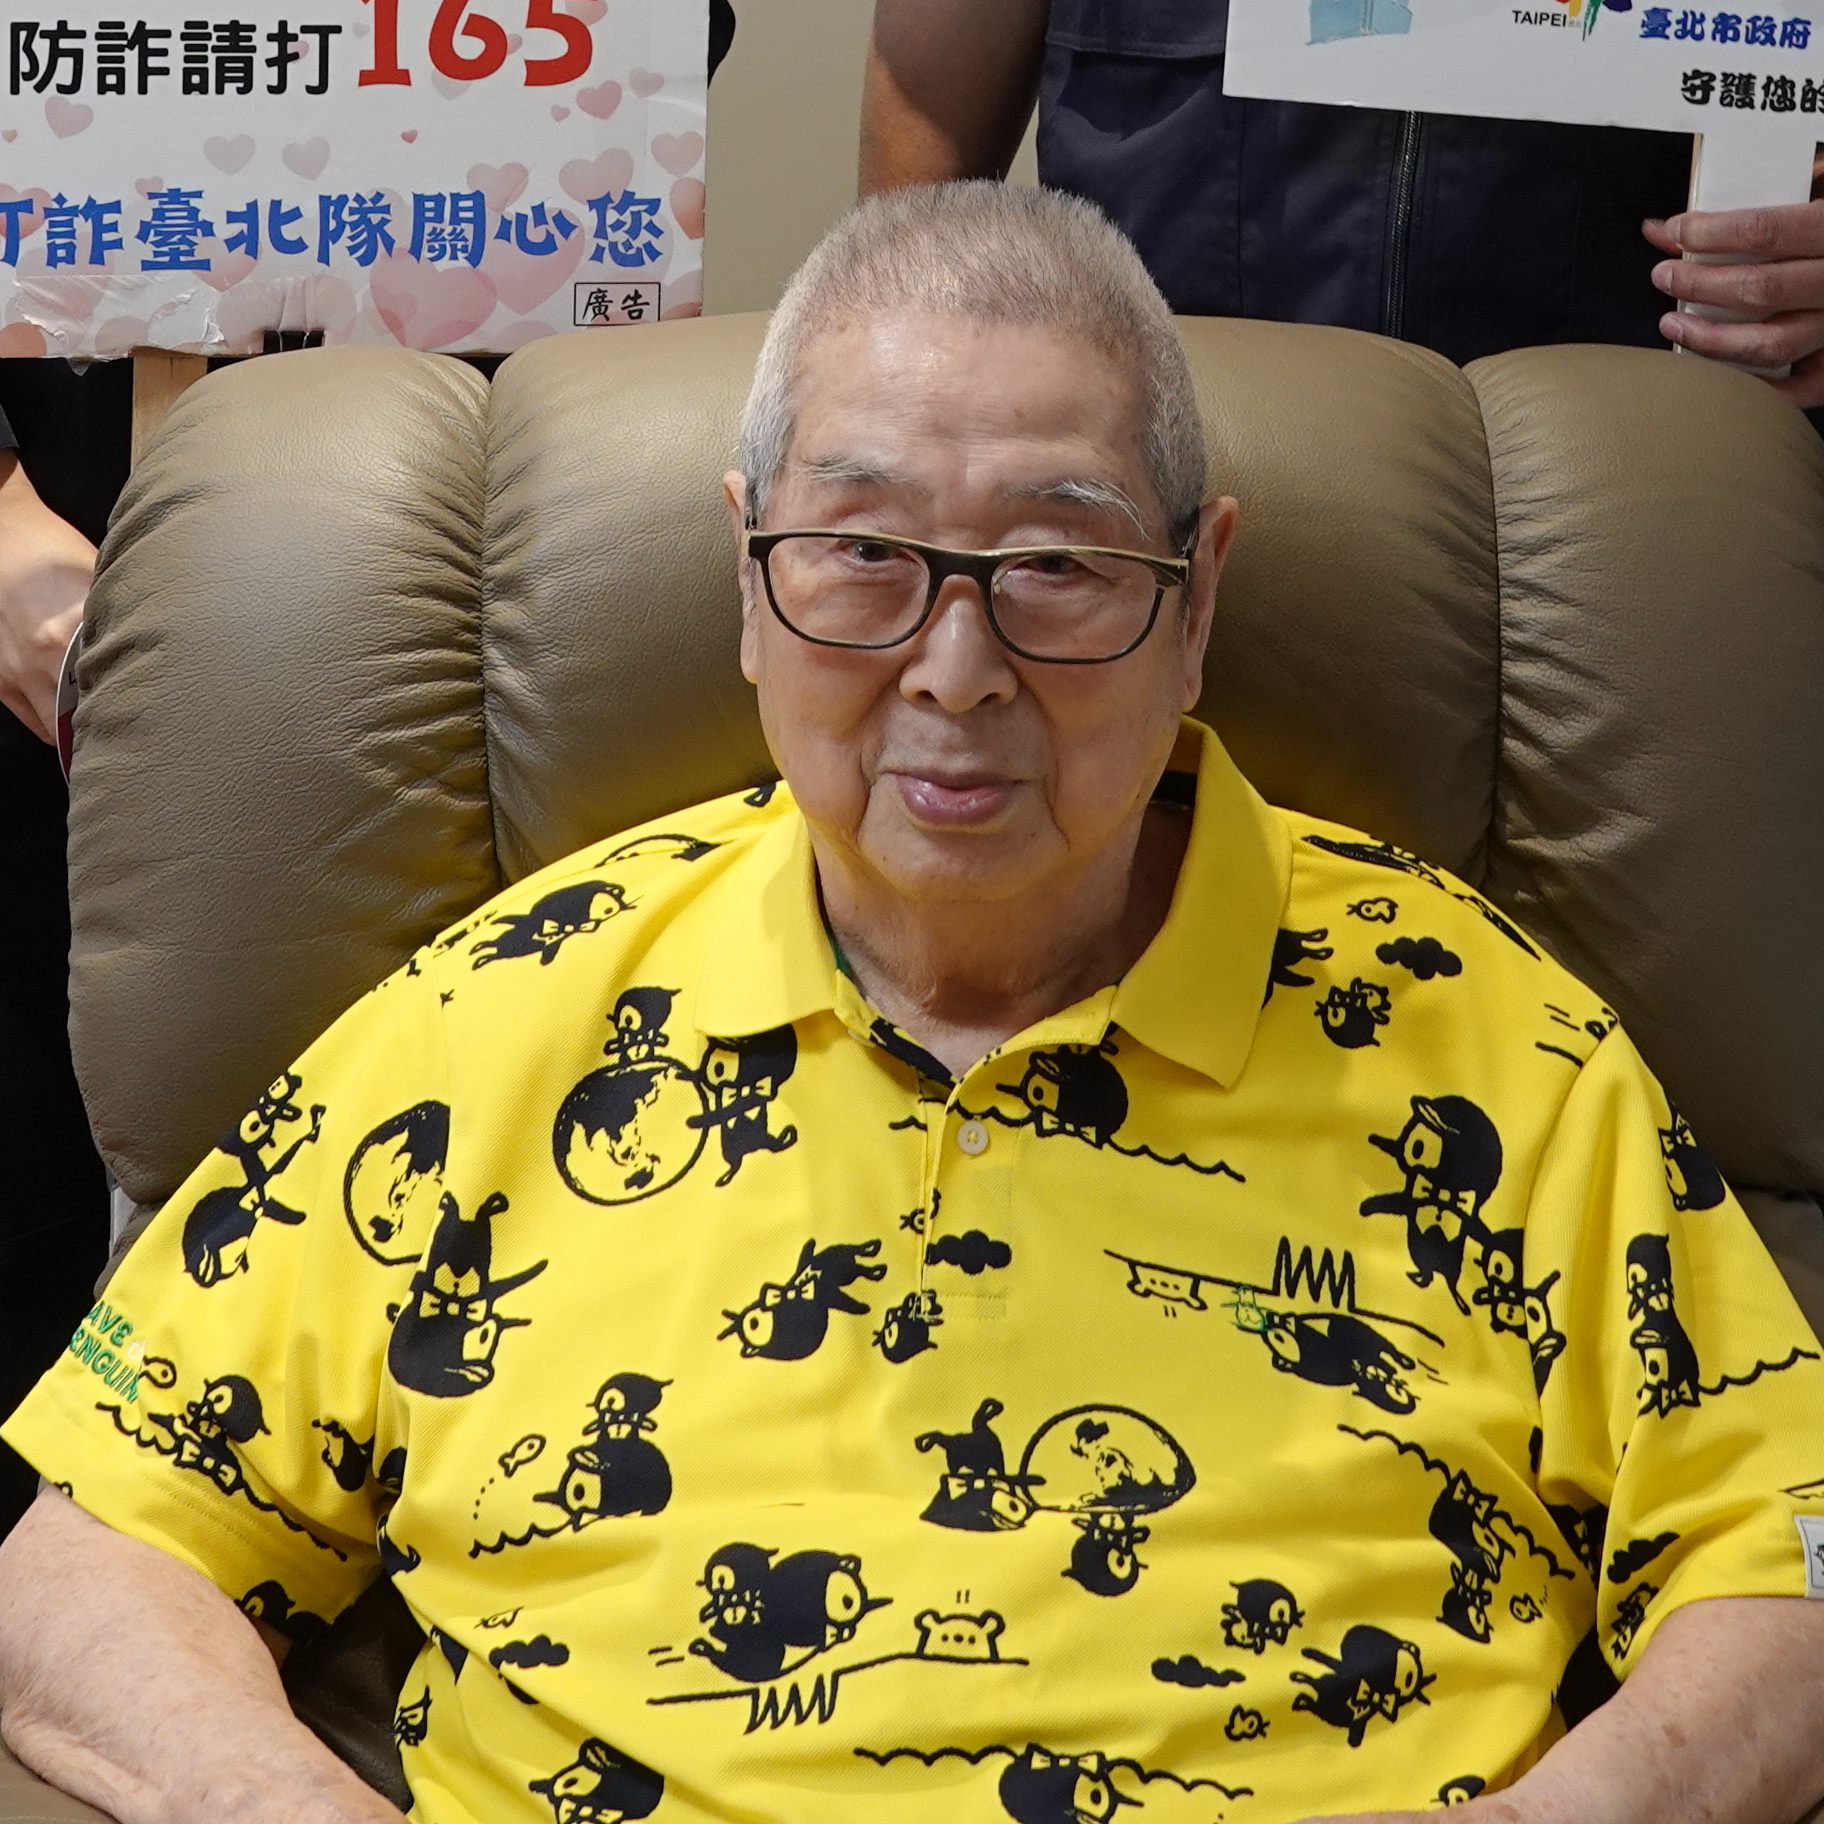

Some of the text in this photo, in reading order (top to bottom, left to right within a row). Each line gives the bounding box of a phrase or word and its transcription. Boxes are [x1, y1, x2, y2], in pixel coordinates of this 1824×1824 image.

[1512, 9, 1567, 28] TAIPEI
[1638, 6, 1813, 51] 臺北市政府
[581, 287, 651, 323] 廣告
[87, 1300, 134, 1348] AVE
[69, 1326, 140, 1405] ENGUIN
